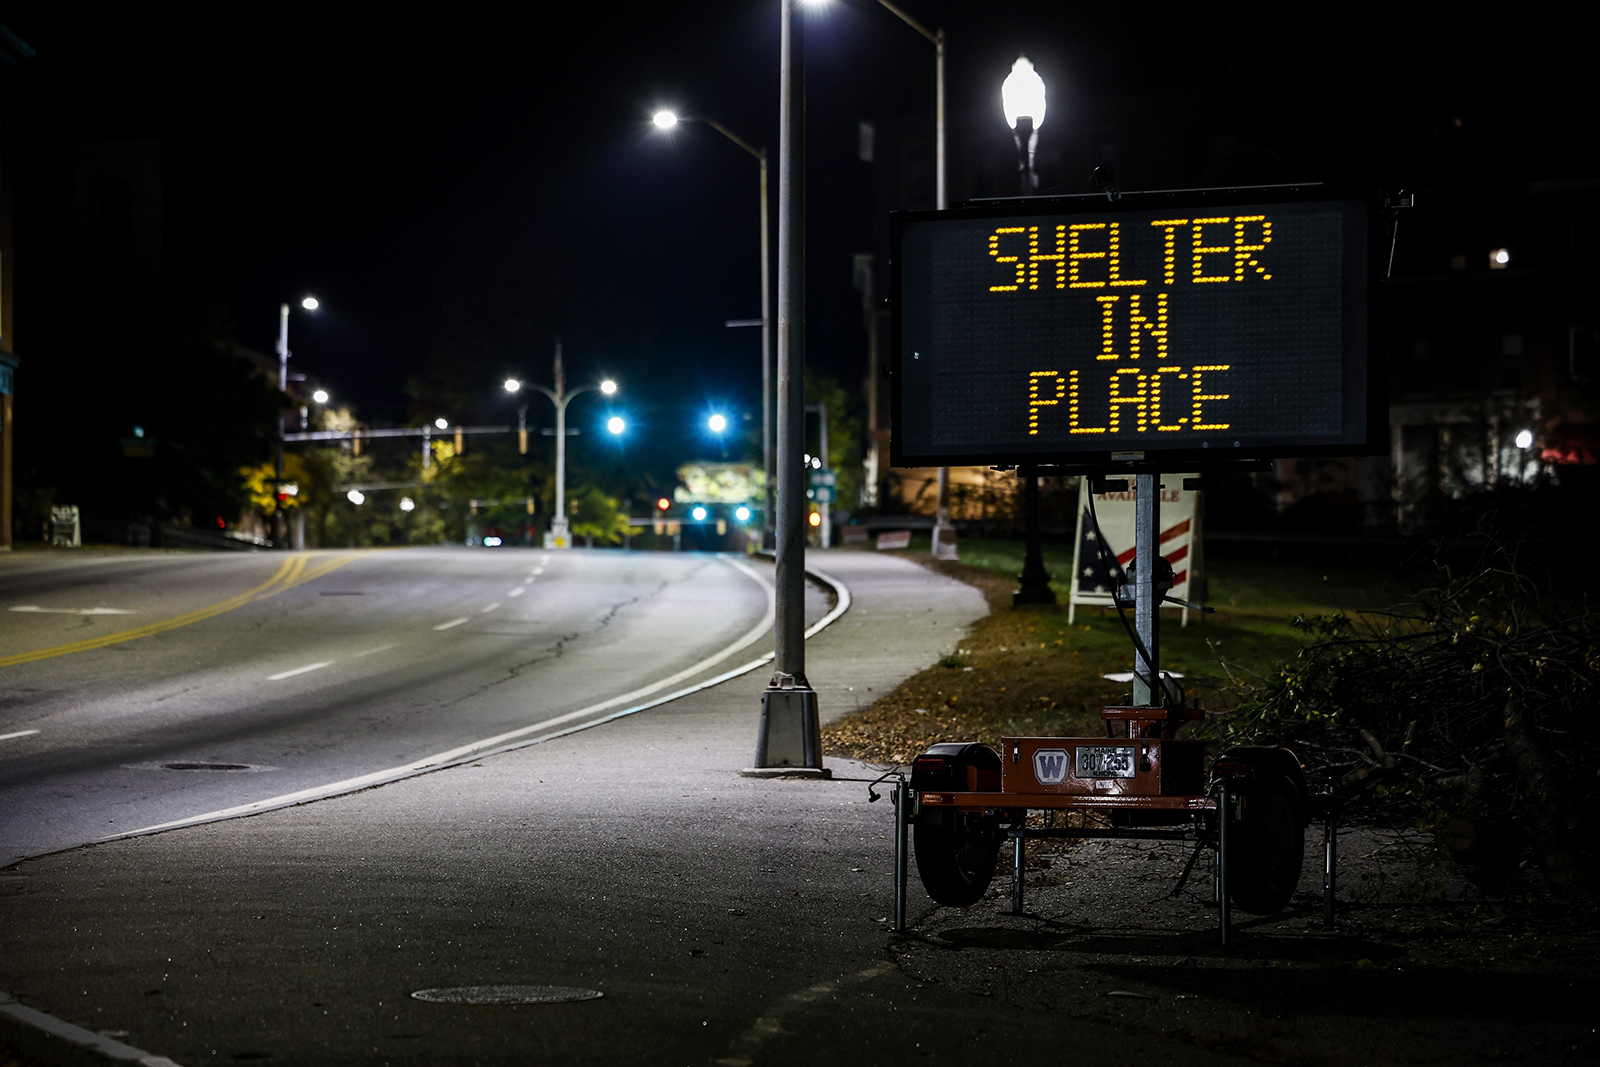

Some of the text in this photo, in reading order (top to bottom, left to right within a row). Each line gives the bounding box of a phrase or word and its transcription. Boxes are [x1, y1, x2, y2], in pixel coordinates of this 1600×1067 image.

[989, 215, 1272, 292] SHELTER
[1096, 293, 1168, 361] IN
[1029, 365, 1230, 434] PLACE
[1097, 491, 1179, 502] AVAILE
[1038, 755, 1064, 778] W
